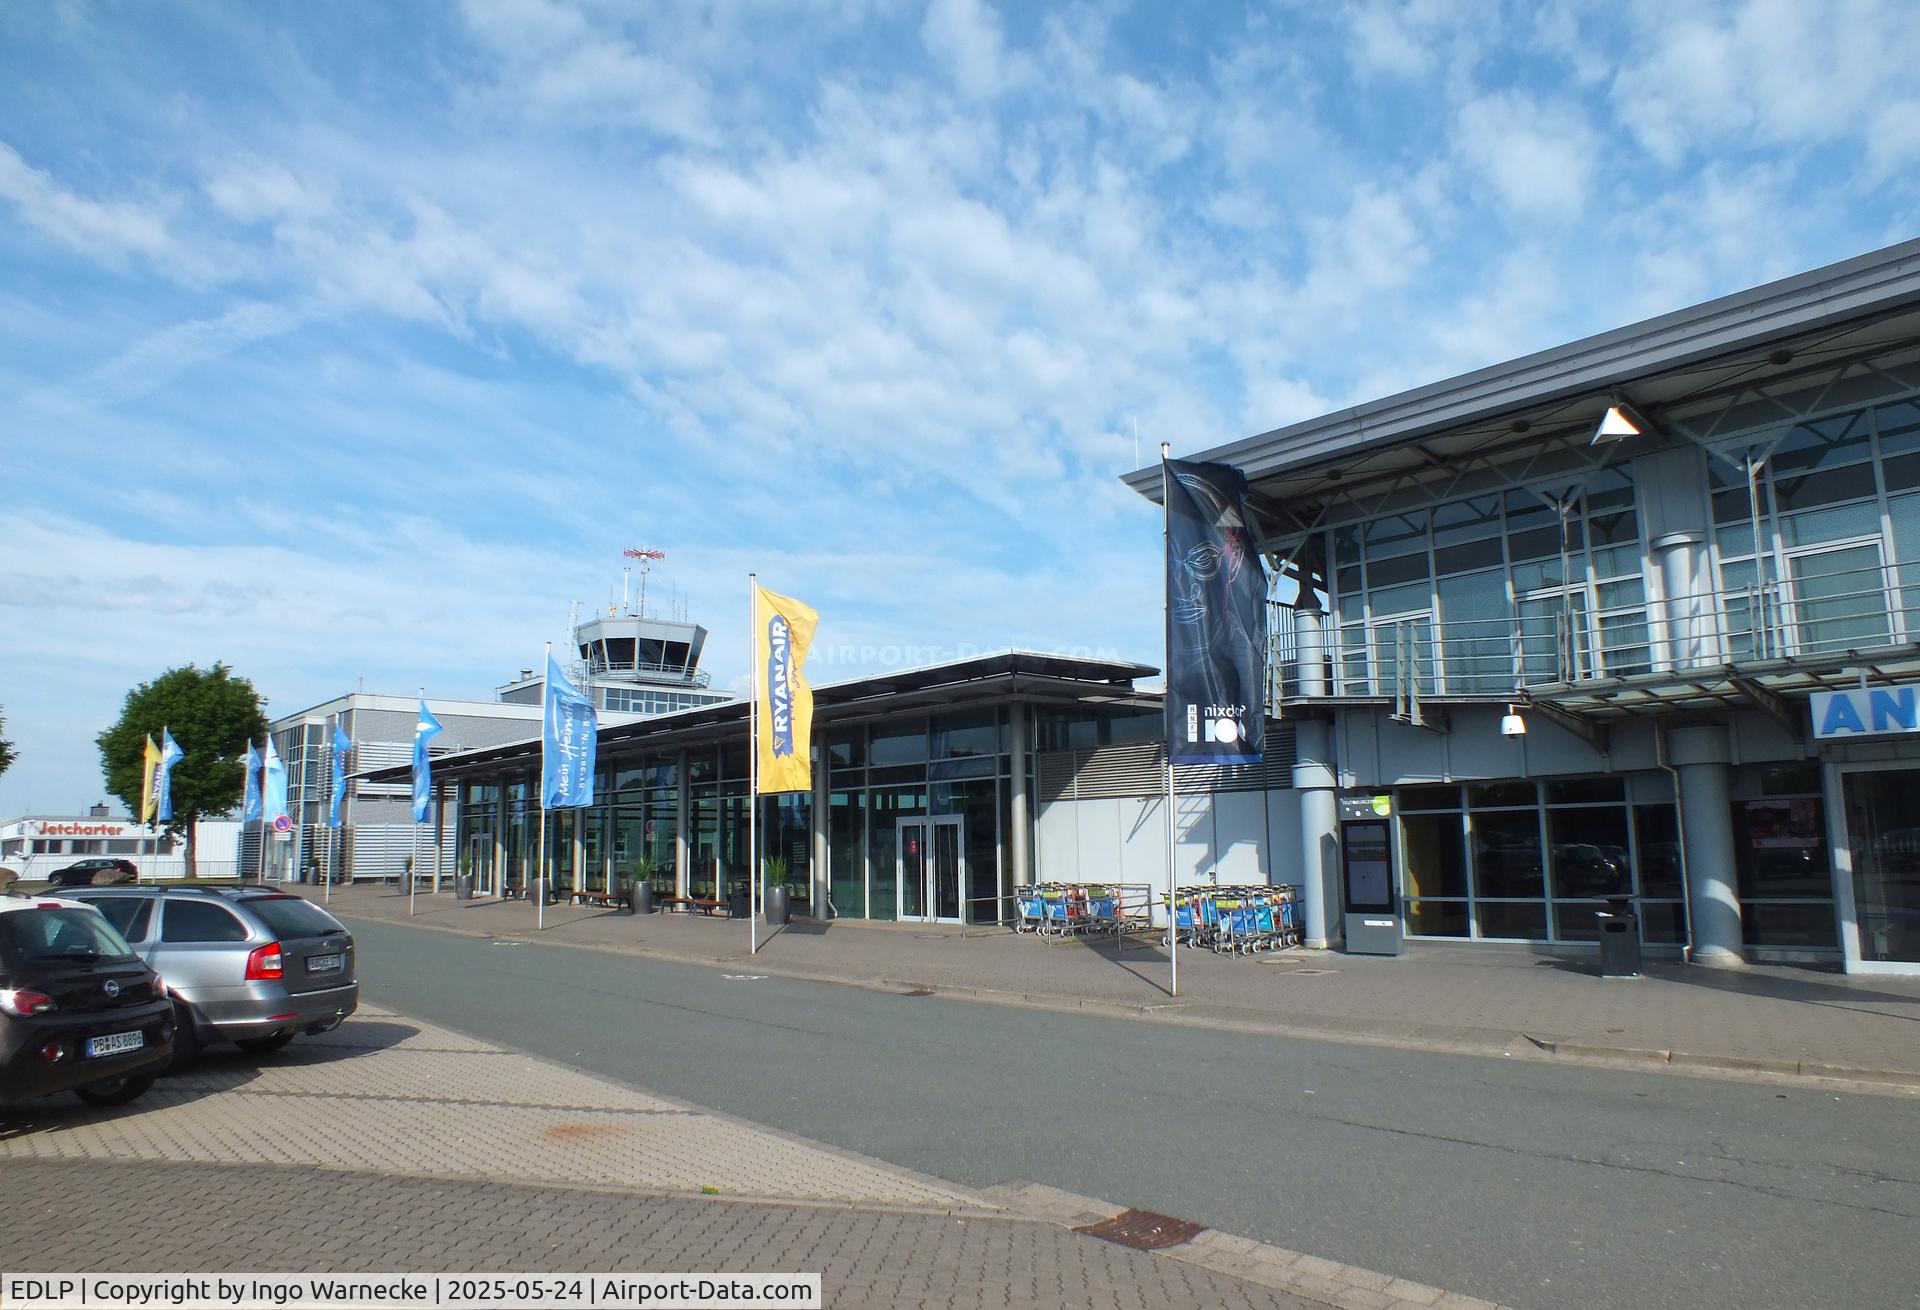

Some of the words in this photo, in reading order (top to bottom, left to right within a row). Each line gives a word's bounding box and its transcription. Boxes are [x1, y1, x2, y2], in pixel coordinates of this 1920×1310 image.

[772, 621, 788, 732] RYANAIR
[1821, 688, 1917, 735] AN
[558, 764, 570, 796] Mein
[39, 821, 124, 836] Jetcharter
[93, 1038, 105, 1052] PB
[112, 1035, 122, 1048] AS
